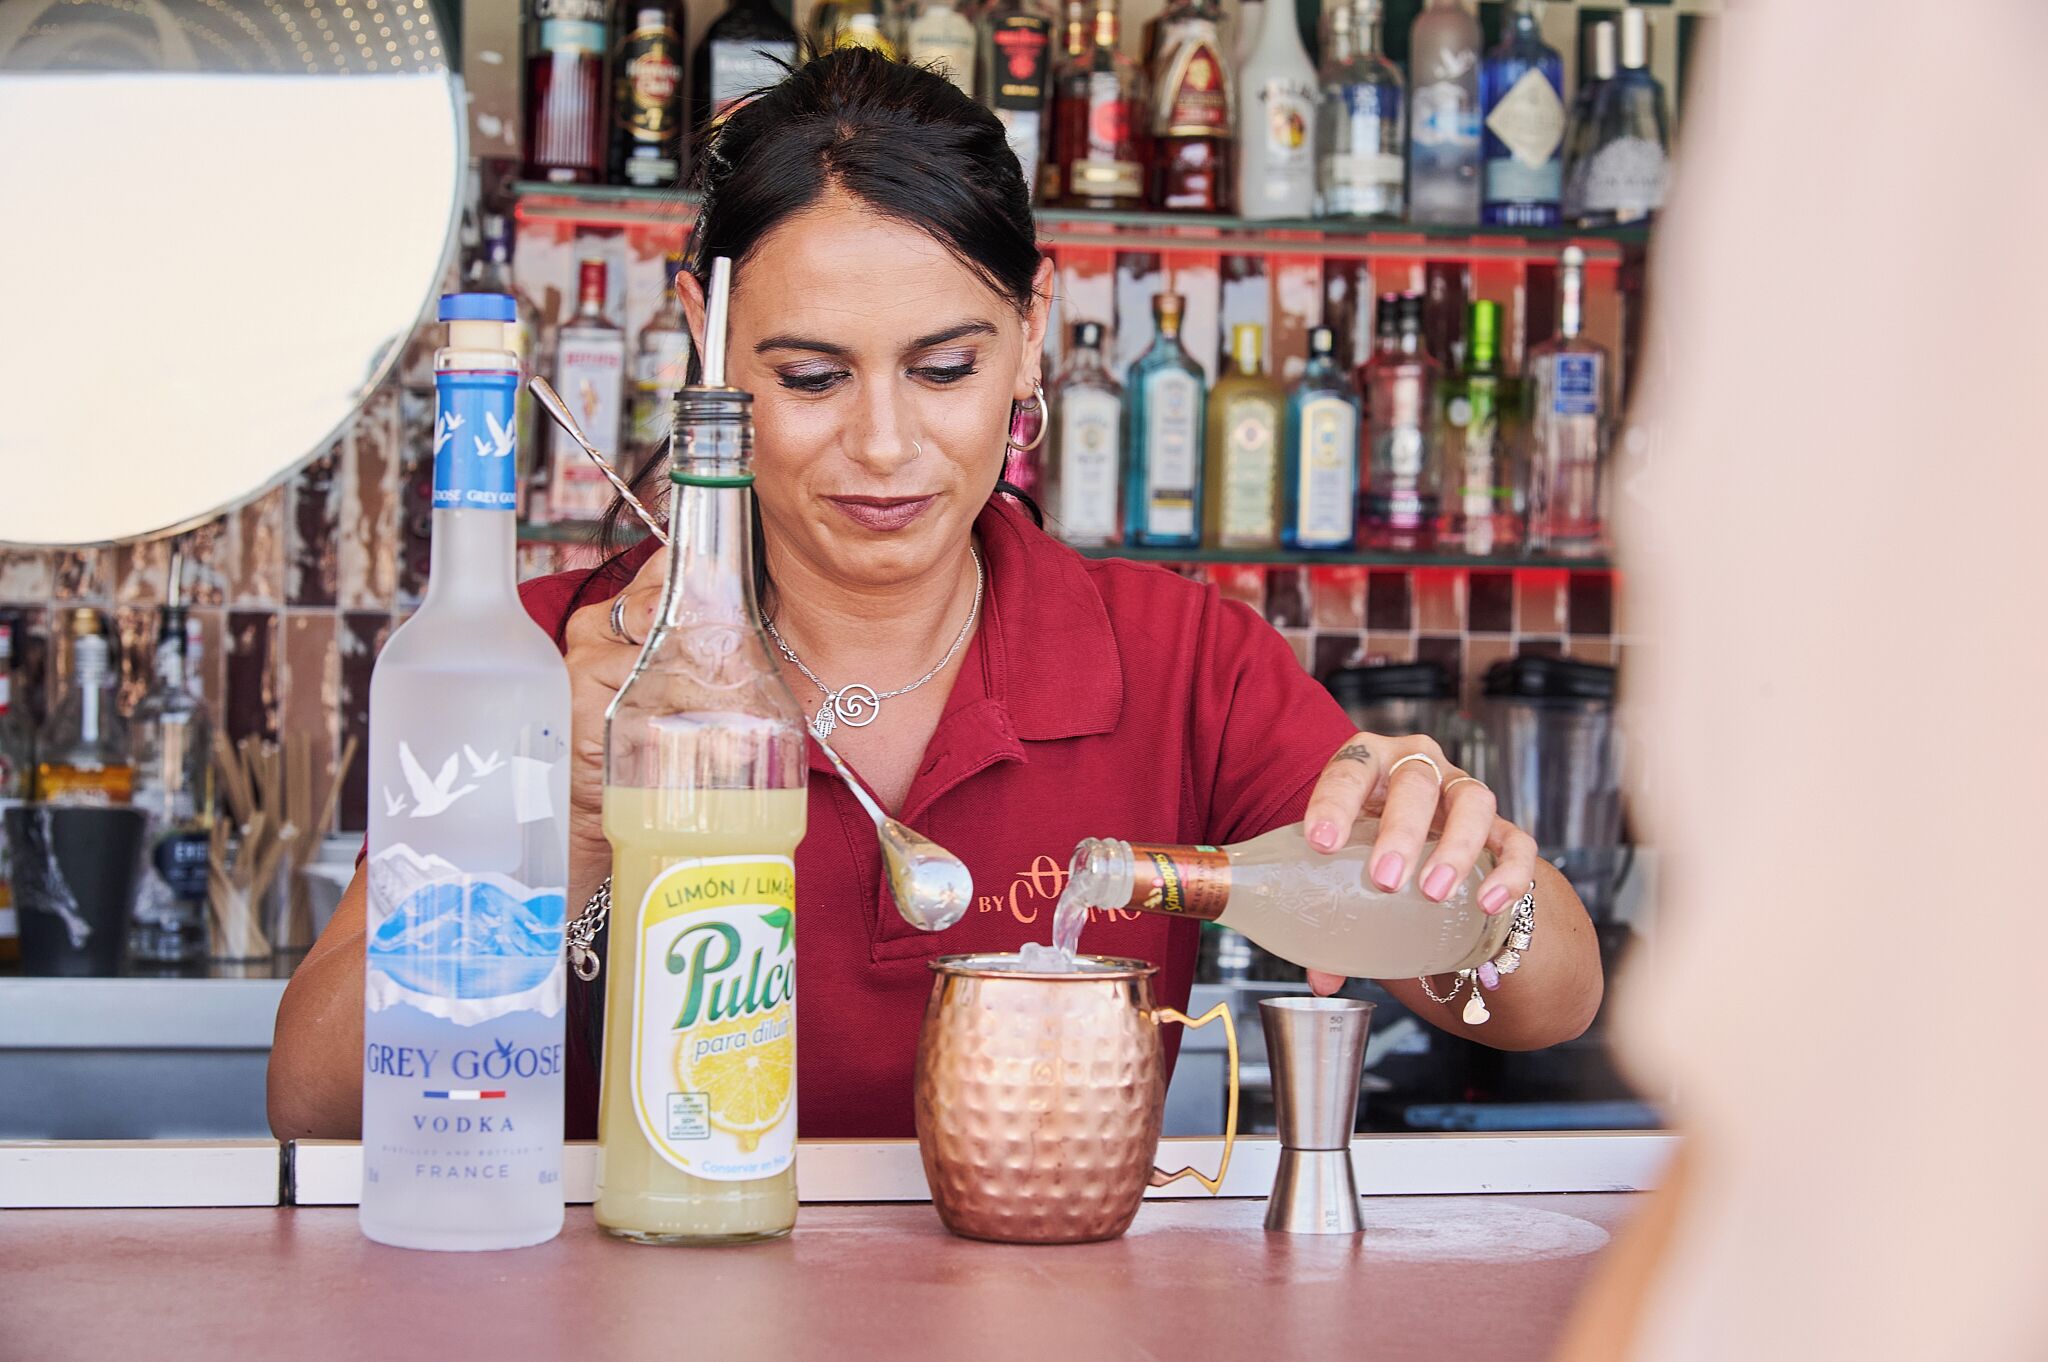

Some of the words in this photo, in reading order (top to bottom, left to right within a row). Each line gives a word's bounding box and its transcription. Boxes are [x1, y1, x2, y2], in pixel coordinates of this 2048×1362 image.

[466, 489, 498, 505] GREY
[665, 877, 735, 908] LIMÓN
[1152, 853, 1183, 911] Schweppes
[979, 896, 1004, 913] BY
[665, 921, 794, 1030] Pulco
[1330, 1016, 1343, 1024] 50
[367, 1042, 438, 1079] GREY
[452, 1038, 562, 1080] GOOSE
[695, 1033, 747, 1062] para
[413, 1115, 515, 1134] VODKA
[416, 1164, 509, 1180] FRANCE
